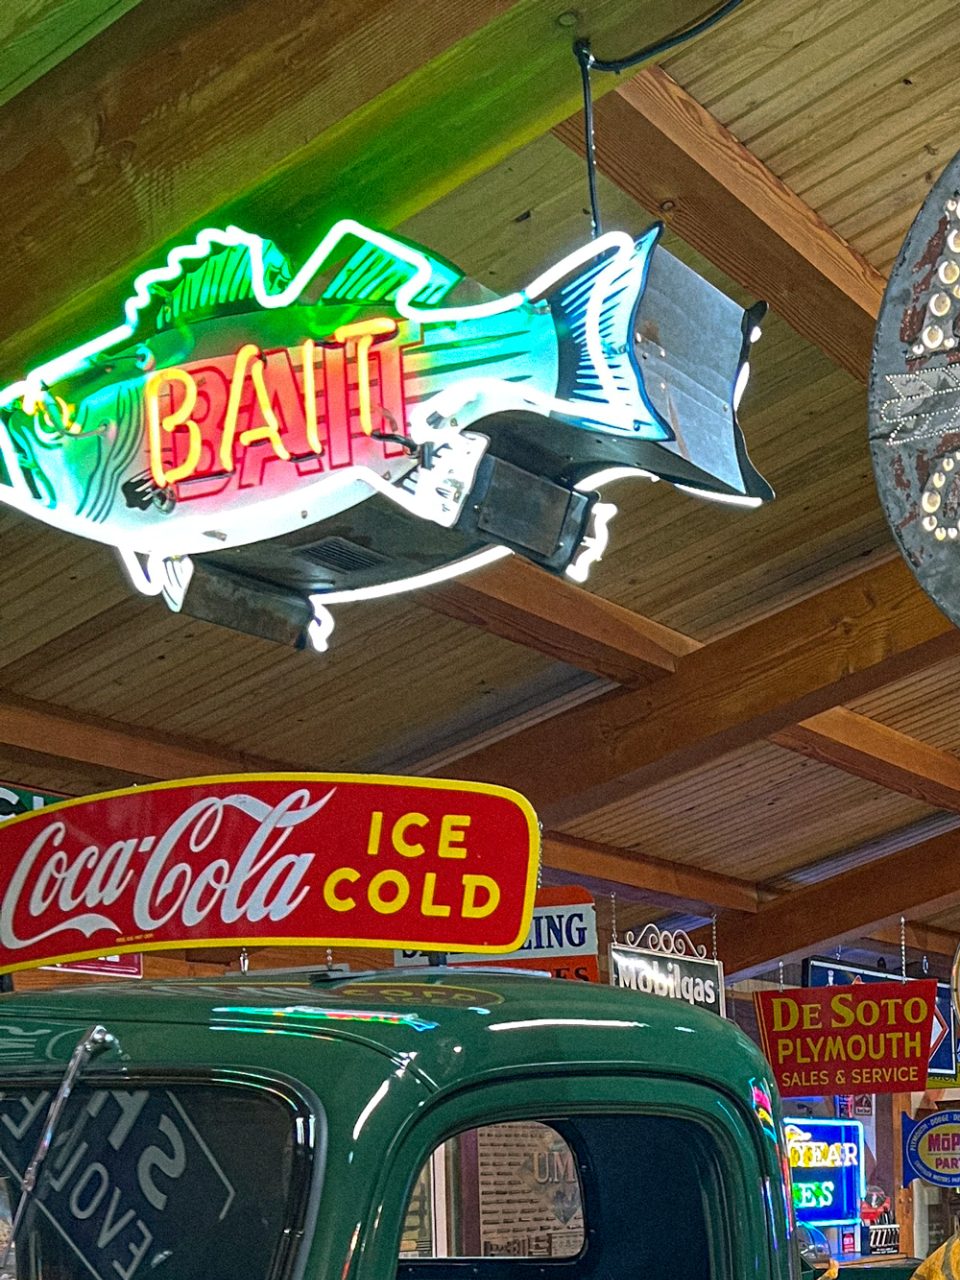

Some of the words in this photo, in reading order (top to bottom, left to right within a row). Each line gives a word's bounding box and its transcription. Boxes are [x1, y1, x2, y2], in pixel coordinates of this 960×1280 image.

[145, 318, 418, 490] BAIT
[367, 811, 471, 858] ICE
[0, 787, 337, 950] Coca-Cola
[323, 868, 500, 918] COLD
[616, 956, 716, 1004] Mobilgas
[778, 1032, 922, 1064] PLYMOUTH
[782, 1071, 829, 1087] SALES
[835, 1070, 846, 1084] &
[852, 1067, 919, 1083] SERVICE
